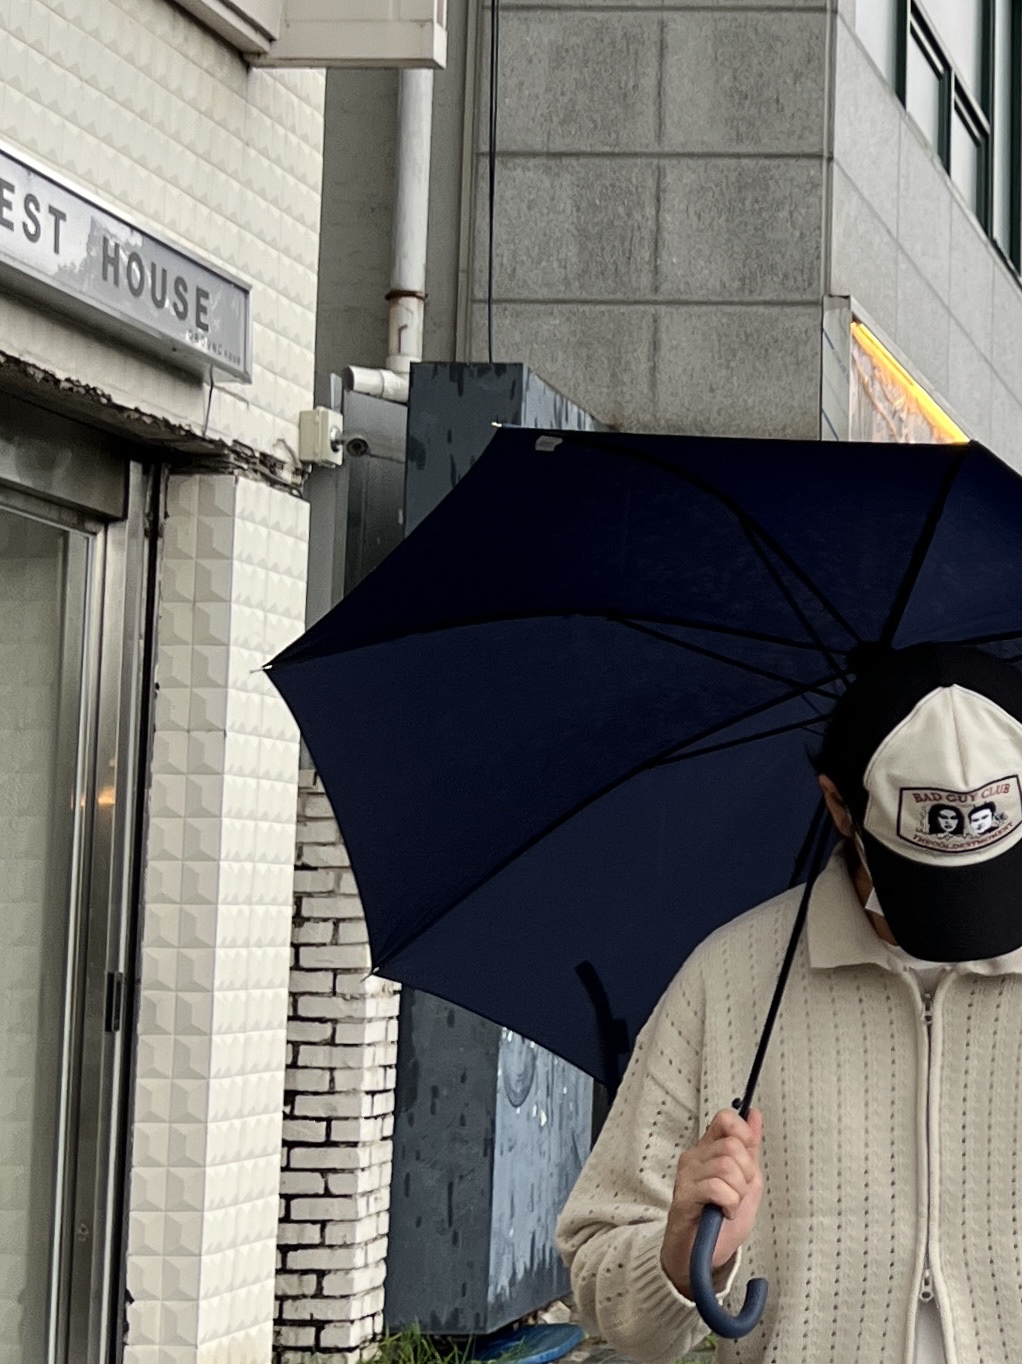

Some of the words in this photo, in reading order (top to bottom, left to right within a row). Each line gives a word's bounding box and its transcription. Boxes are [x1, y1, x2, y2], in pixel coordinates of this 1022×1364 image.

[101, 235, 210, 333] HOUSE
[912, 792, 942, 803] BAD
[945, 792, 978, 803] GUY
[981, 783, 1011, 799] CLUB
